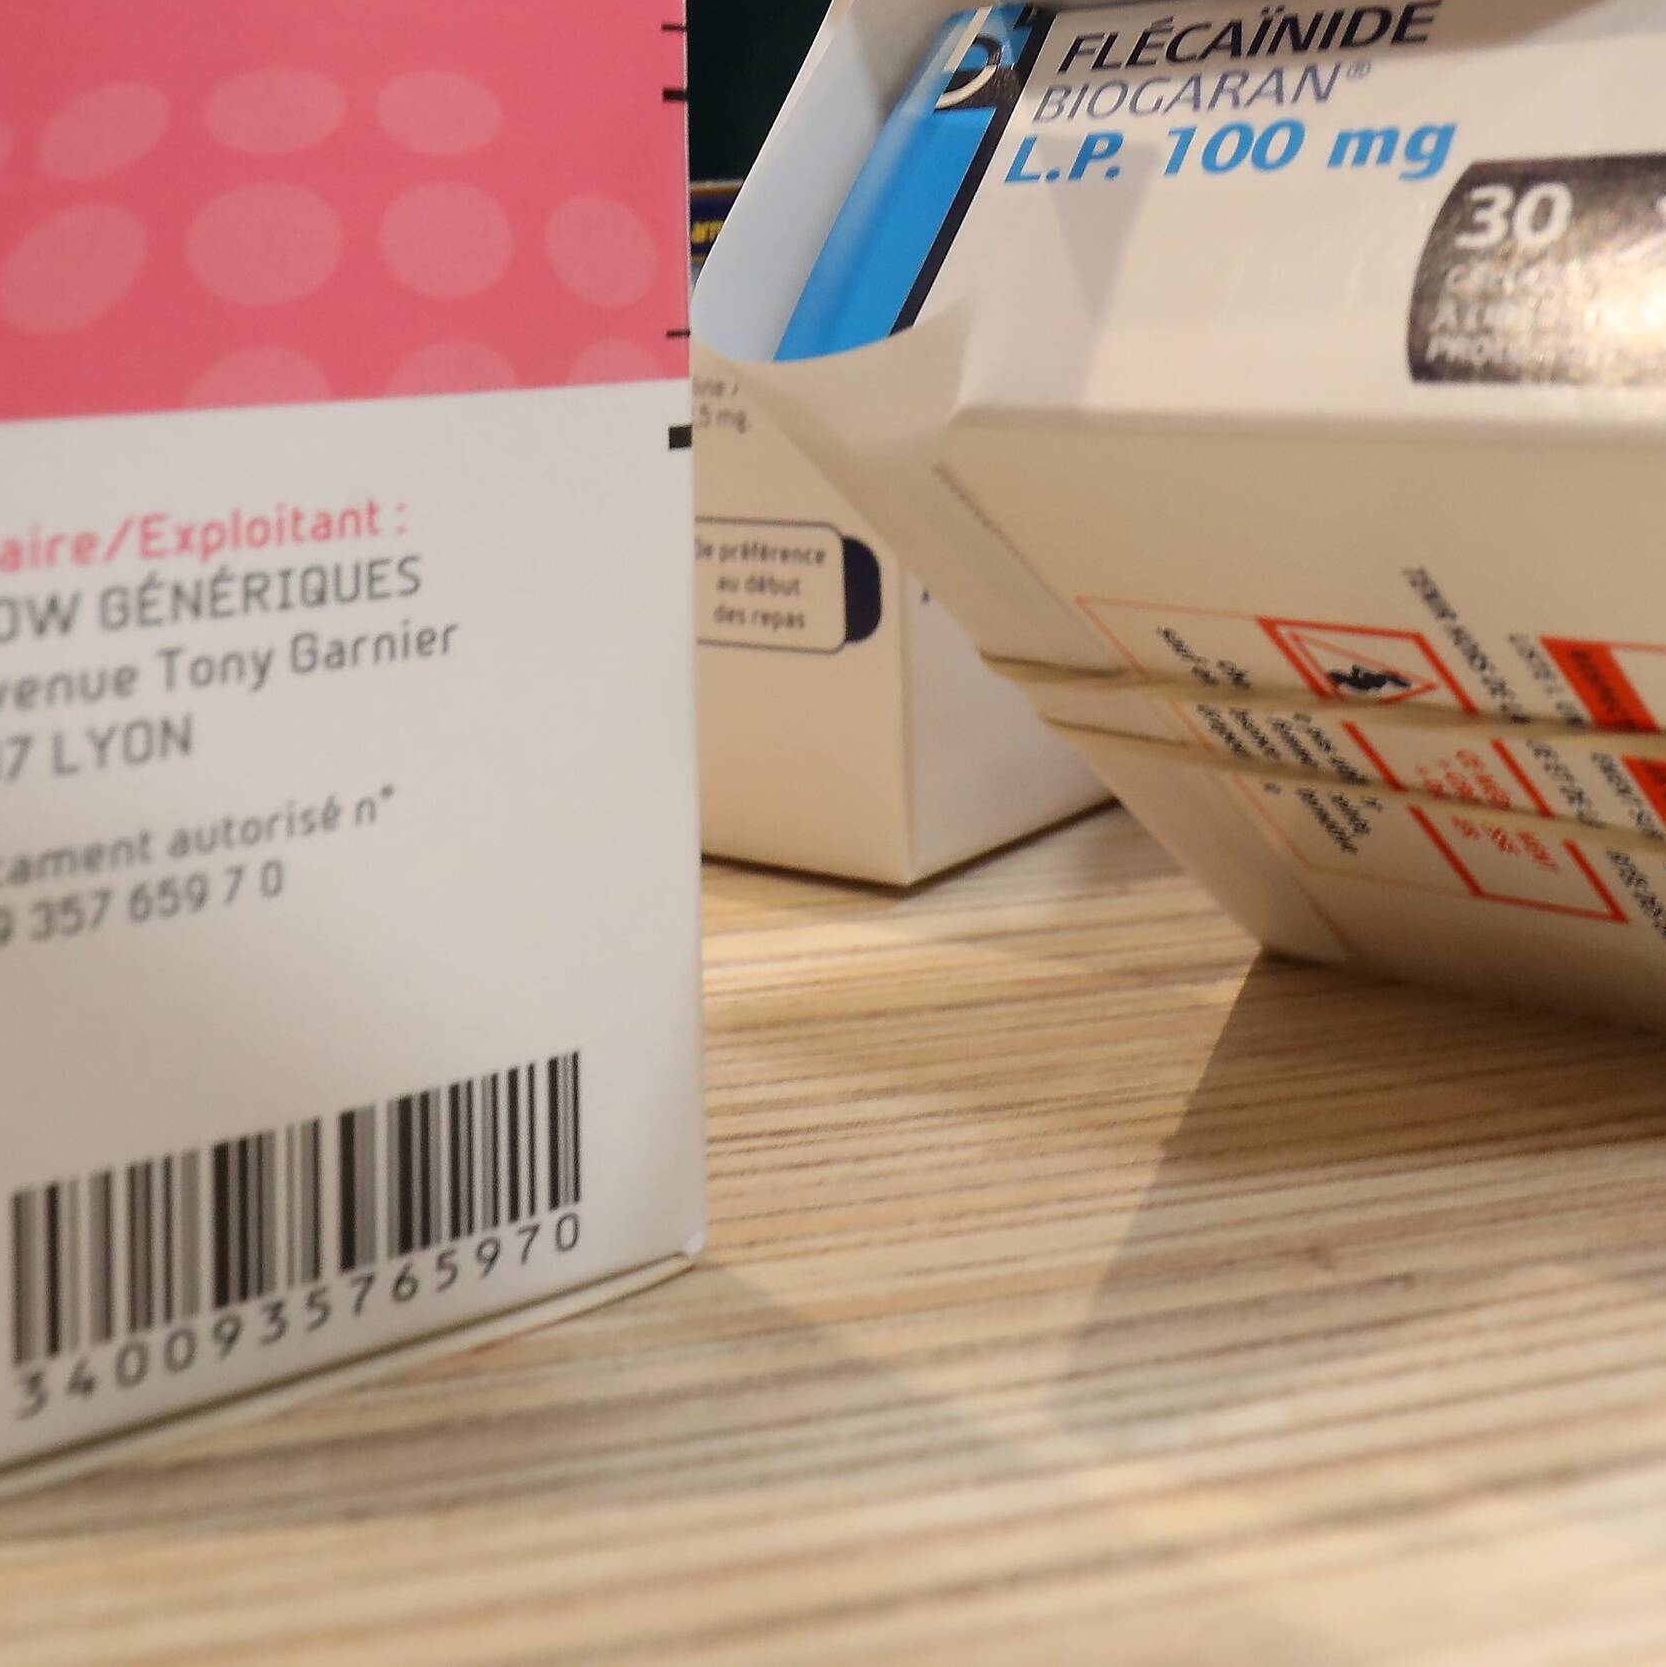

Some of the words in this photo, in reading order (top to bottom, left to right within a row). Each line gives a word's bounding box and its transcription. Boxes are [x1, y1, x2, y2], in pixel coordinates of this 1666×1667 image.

[1057, 0, 1443, 75] FLÉCAÏNIDE
[1003, 131, 1125, 186] L.P.
[1164, 119, 1307, 178] 100
[1326, 121, 1457, 181] mg
[1454, 182, 1574, 251] 30
[99, 555, 423, 632] GÉNÉRIQUES
[157, 643, 275, 694] Tony
[290, 618, 459, 676] Garnier
[51, 712, 194, 777] LYON
[168, 796, 341, 861] autorisé
[28, 886, 113, 943] 357
[128, 873, 210, 925] 659
[222, 865, 244, 904] 7
[259, 859, 285, 899] 0
